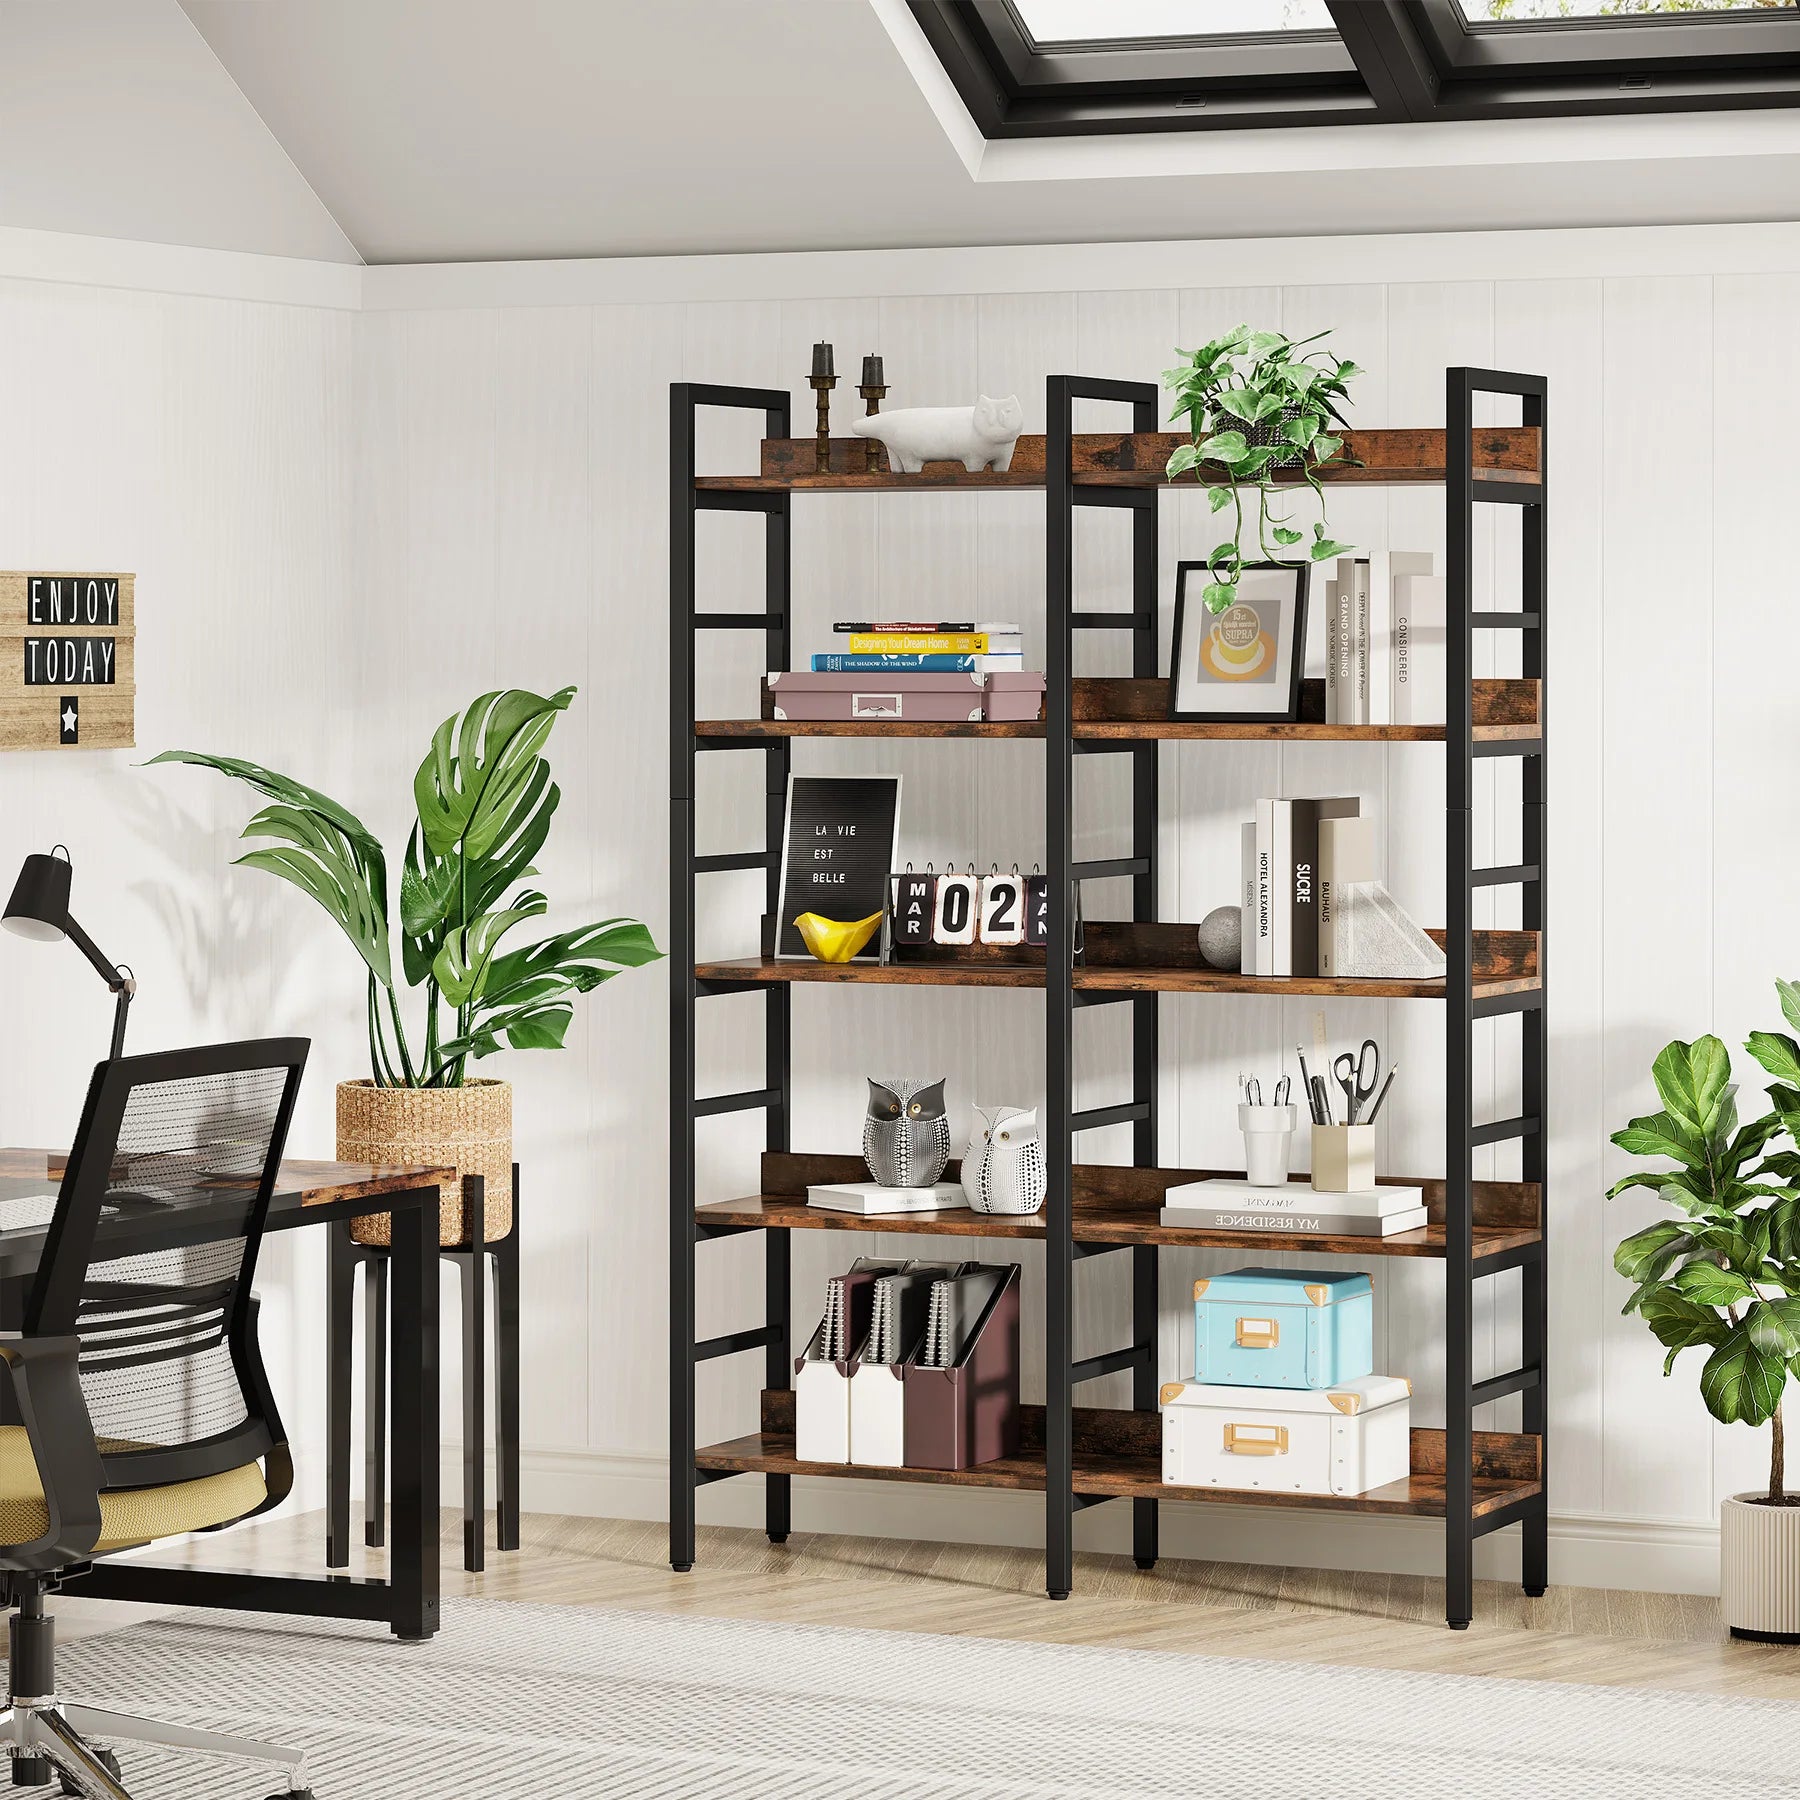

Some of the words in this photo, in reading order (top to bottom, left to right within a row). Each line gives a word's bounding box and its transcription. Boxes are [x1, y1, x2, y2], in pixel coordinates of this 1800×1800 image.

[32, 580, 116, 624] ENJOY
[1341, 595, 1349, 629] GRAND
[853, 637, 887, 652] Designing
[888, 637, 903, 649] Your
[904, 637, 927, 649] Dream
[927, 637, 949, 649] Home
[1225, 629, 1253, 641] SUPRA
[1358, 638, 1366, 649] THE
[1398, 617, 1408, 683] CONSIDERED
[28, 639, 113, 682] TODAY
[1341, 633, 1349, 678] OPENING
[1358, 650, 1366, 670] POWER
[1358, 670, 1366, 679] OF
[815, 825, 827, 836] LA
[837, 825, 856, 836] VIE
[814, 849, 833, 860] EST
[1260, 852, 1268, 882] HOTEL
[812, 873, 846, 883] BELLE
[1296, 863, 1311, 903] SUCRE
[907, 883, 926, 934] MAR
[1260, 883, 1268, 938] ALEXANDRA
[1322, 881, 1330, 923] BAUHAUS
